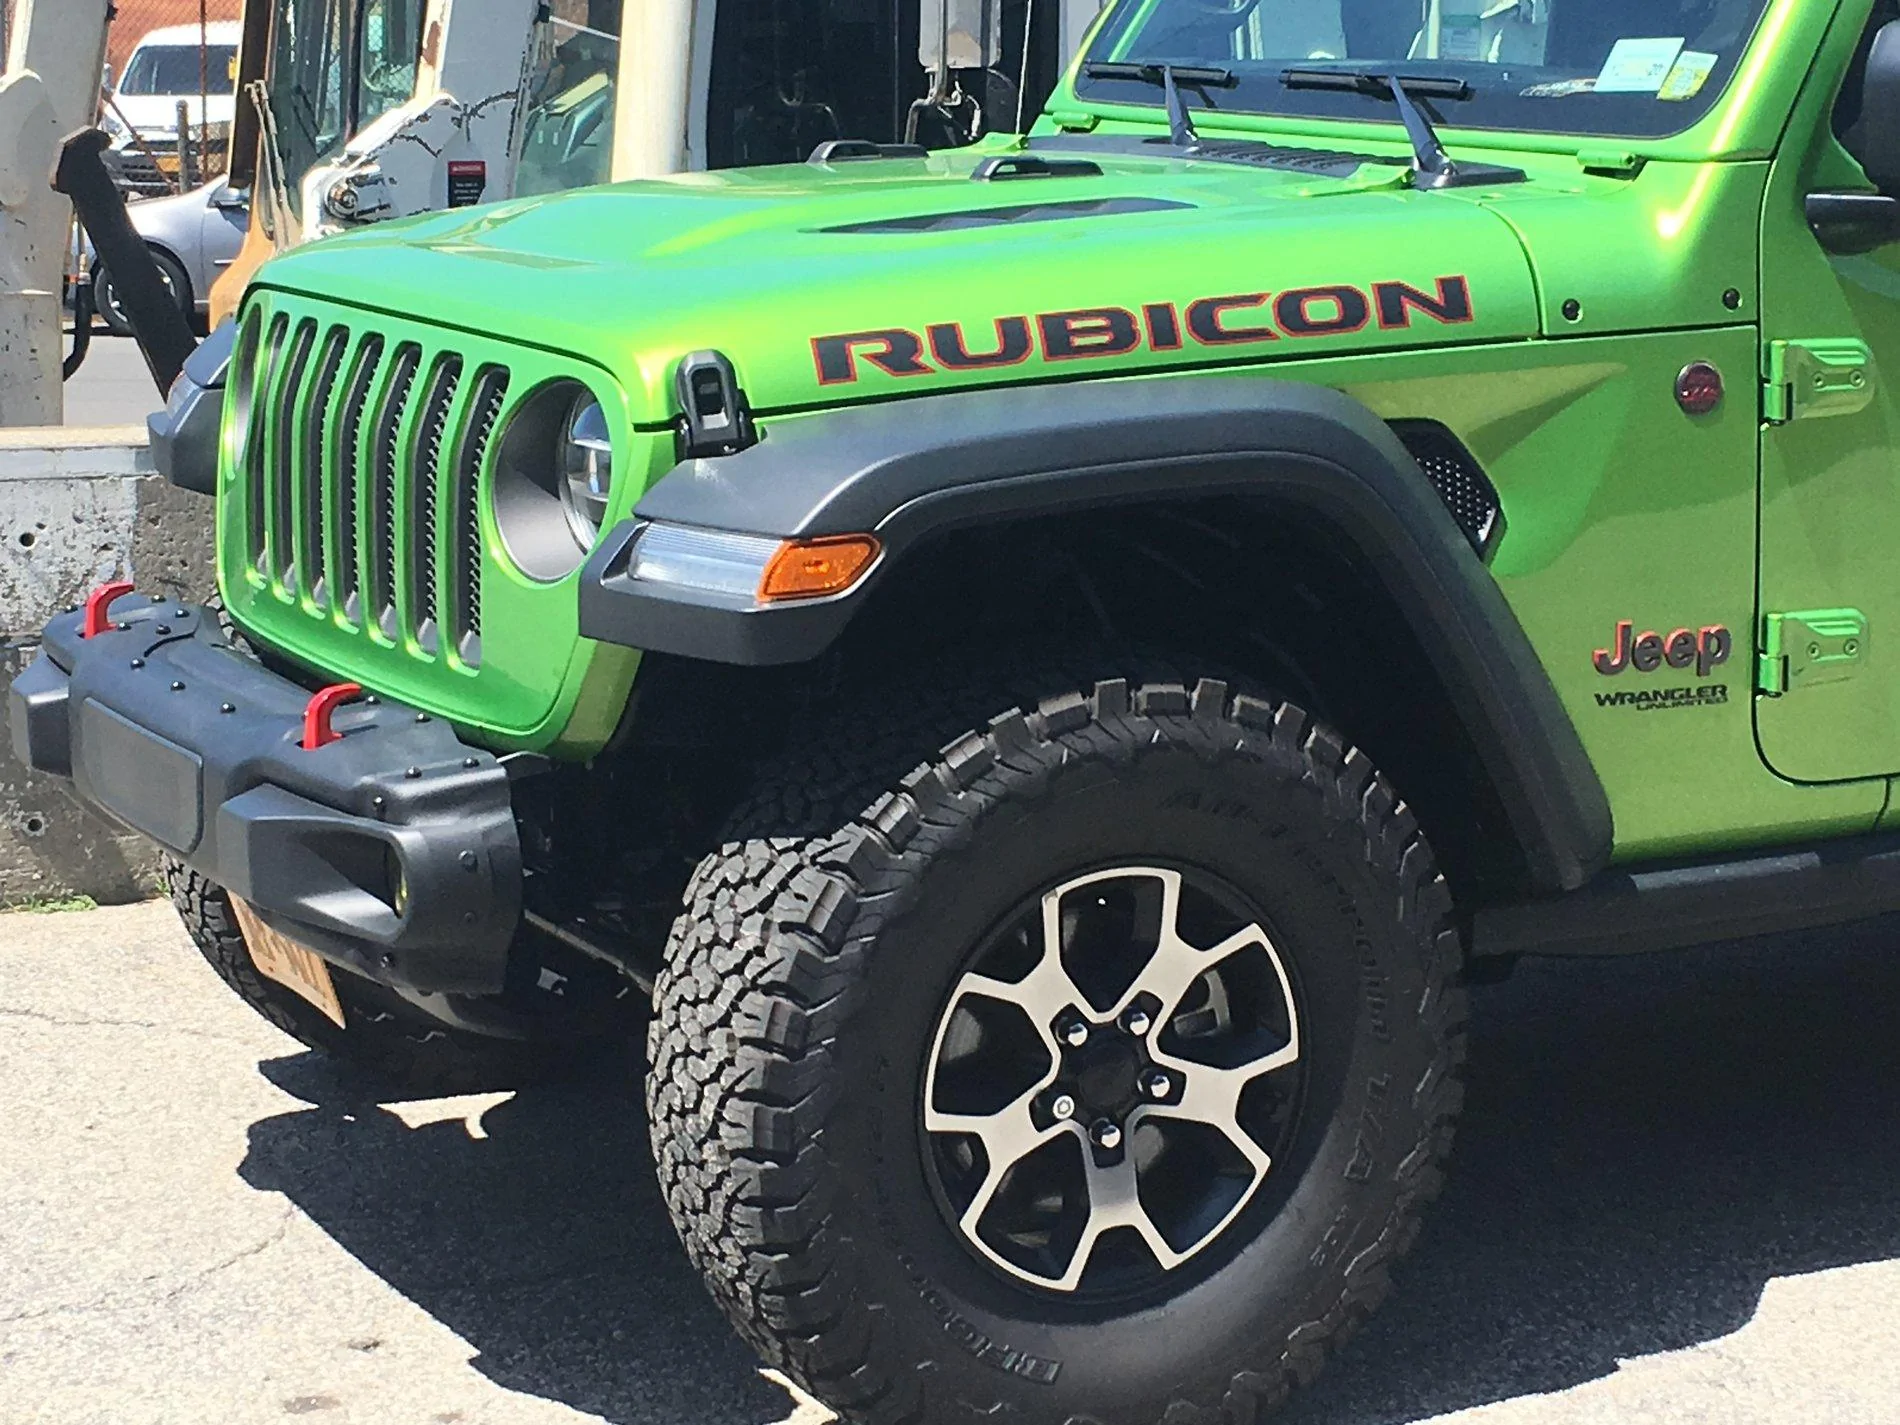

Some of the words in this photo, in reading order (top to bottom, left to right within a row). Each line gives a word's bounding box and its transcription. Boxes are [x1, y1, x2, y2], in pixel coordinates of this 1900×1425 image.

[810, 274, 1473, 386] RUBICON
[1592, 619, 1732, 677] Jeep
[1595, 684, 1728, 706] WRANGLER
[1636, 697, 1729, 712] UNLIMITED
